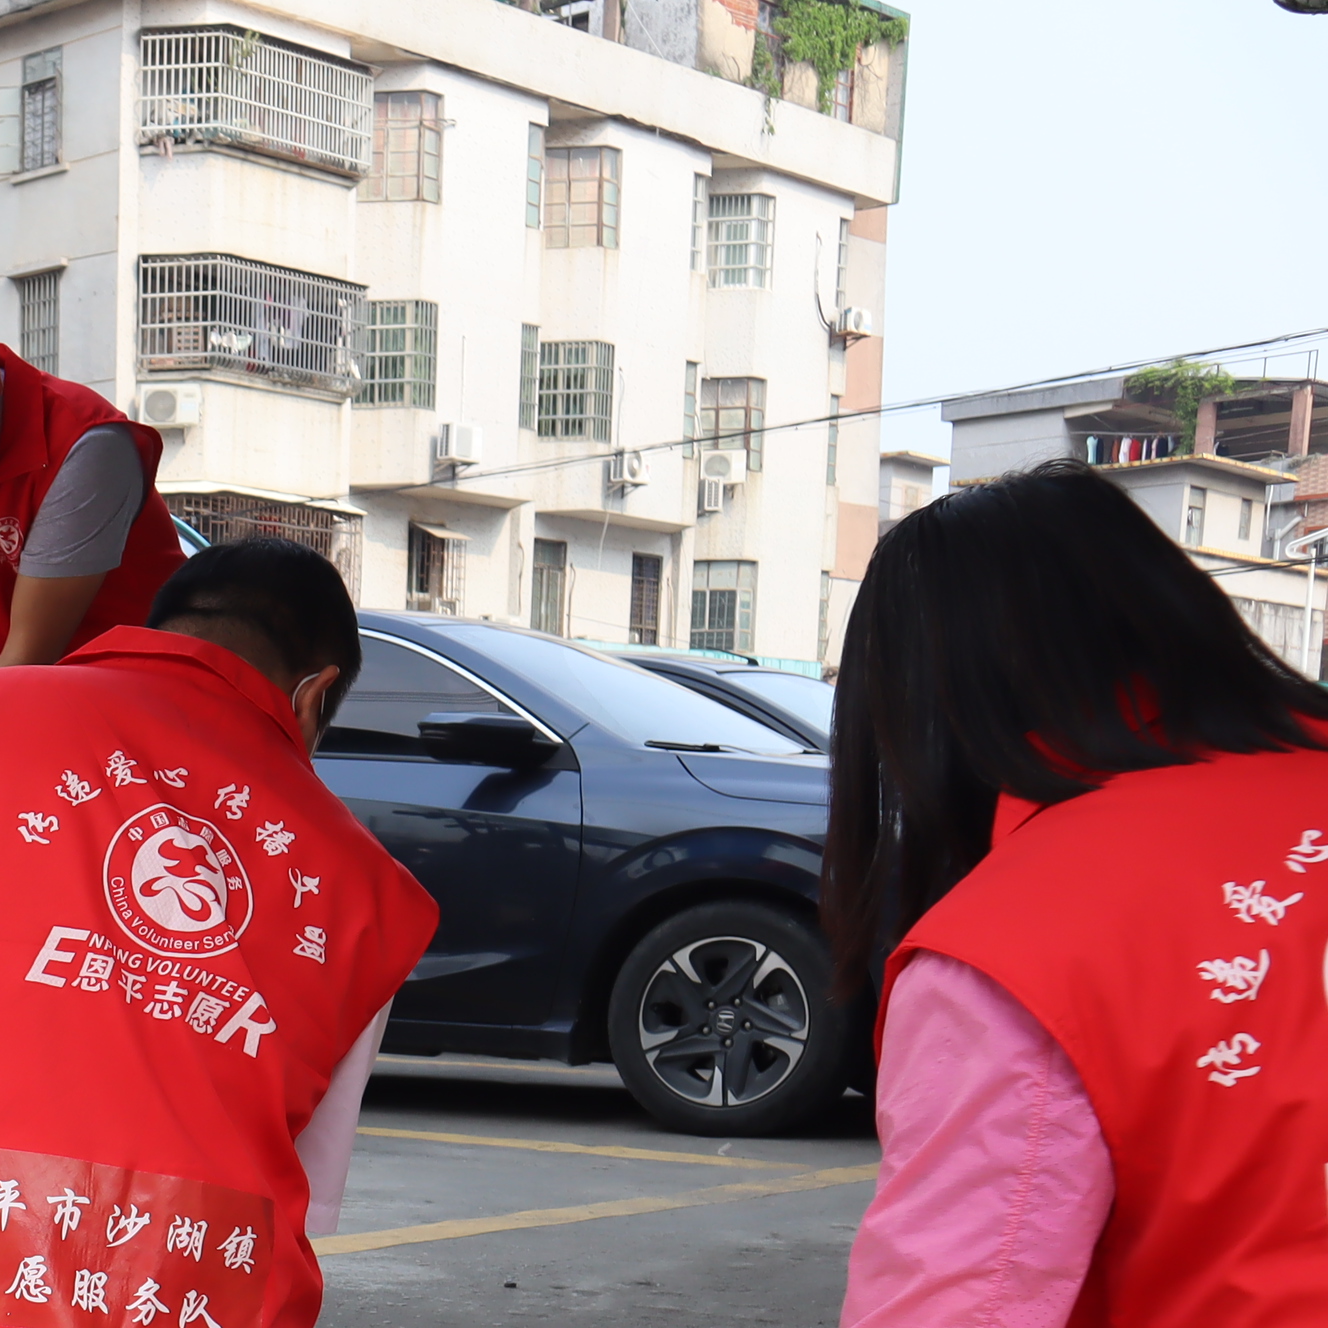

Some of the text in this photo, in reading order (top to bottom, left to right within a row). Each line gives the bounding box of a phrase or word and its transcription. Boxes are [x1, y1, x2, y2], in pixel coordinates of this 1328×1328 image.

[110, 876, 235, 951] China Volunteer Serv
[71, 952, 231, 1036] 恩平志愿
